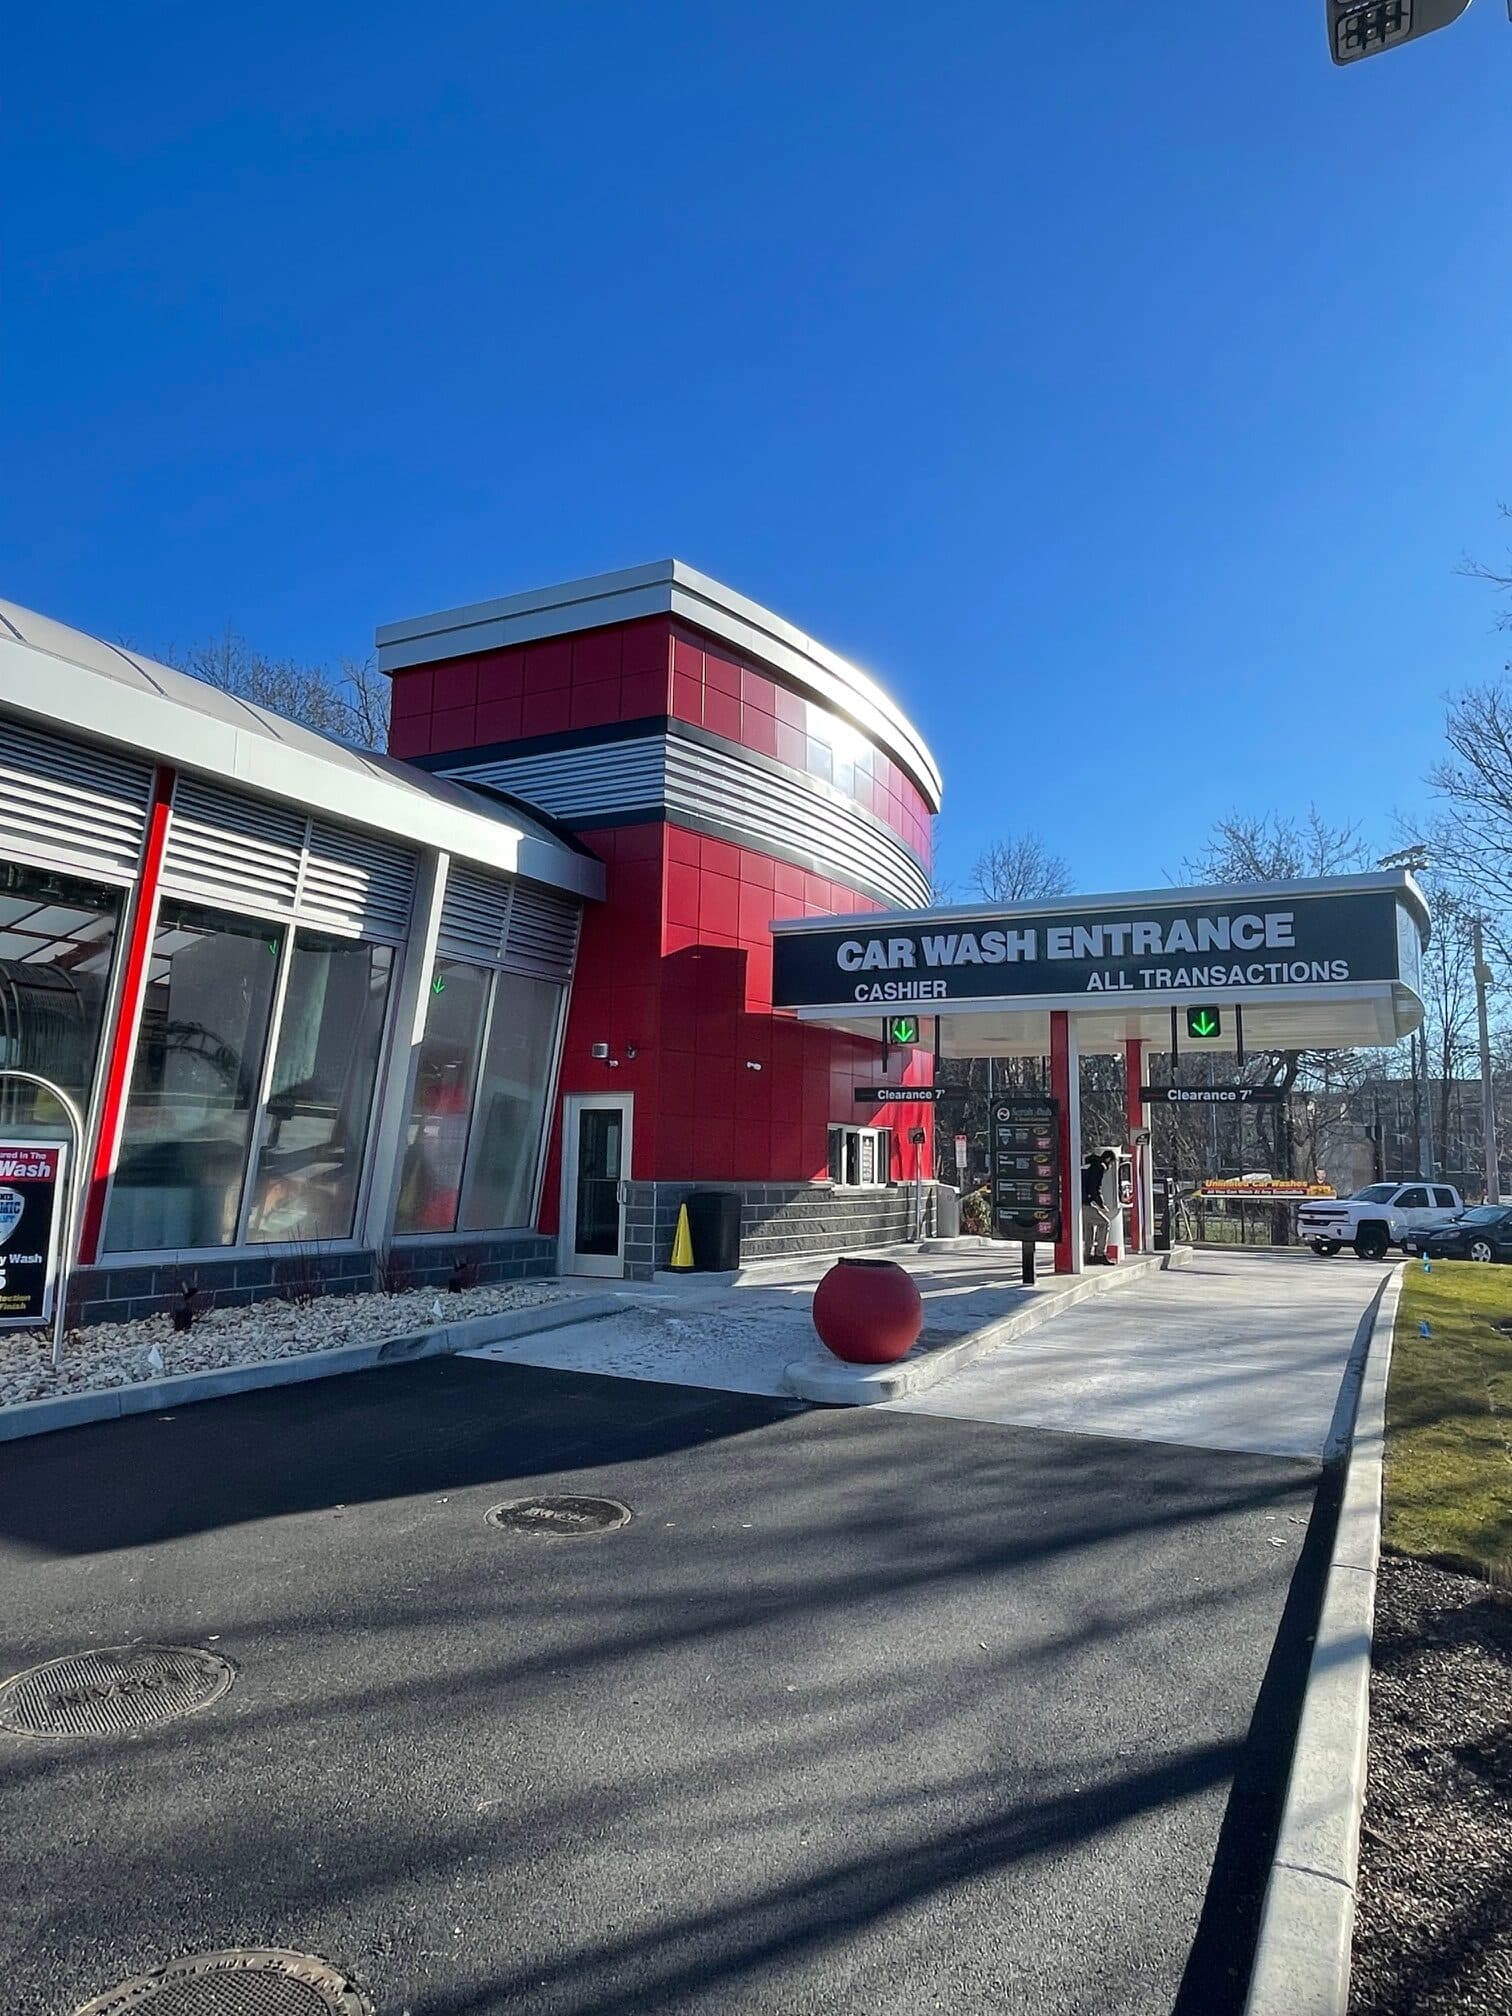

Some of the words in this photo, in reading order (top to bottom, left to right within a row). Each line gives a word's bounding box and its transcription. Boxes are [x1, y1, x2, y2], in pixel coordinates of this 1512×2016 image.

[836, 938, 916, 972] CAR
[920, 929, 1036, 968] WASH
[1047, 912, 1296, 960] ENTRANCE
[1086, 971, 1133, 991] ALL
[1139, 959, 1349, 988] TRANSACTIONS
[854, 980, 947, 1002] CASHIER
[877, 1089, 932, 1100] Clearance
[1167, 1089, 1237, 1100] Clearance
[30, 1152, 47, 1160] The
[0, 1160, 51, 1178] Wash
[1205, 1179, 1249, 1187] Unlimited
[9, 1253, 42, 1264] Wash
